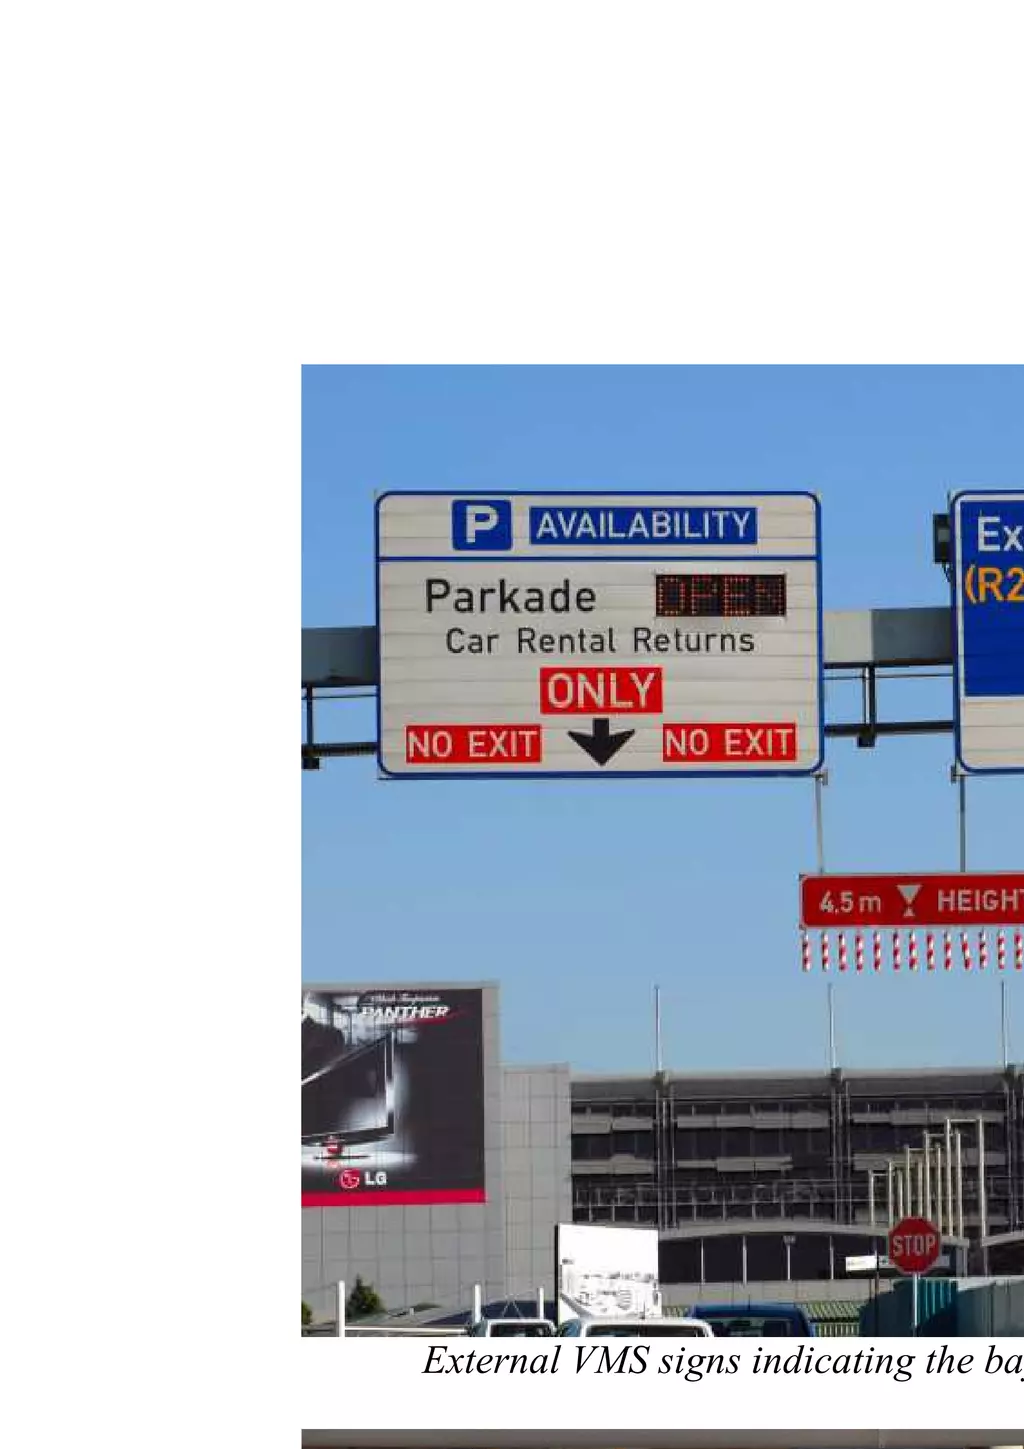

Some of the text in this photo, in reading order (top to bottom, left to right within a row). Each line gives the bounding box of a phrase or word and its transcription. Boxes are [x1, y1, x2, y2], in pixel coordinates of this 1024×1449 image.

[466, 506, 751, 543] P AVAILABILITY
[426, 577, 783, 616] Parkade OPEN
[446, 627, 755, 655] Car Rental Returns
[547, 673, 655, 708] ONLY
[408, 730, 538, 759] NO EXIT
[664, 728, 793, 757] NO EXIT
[362, 1006, 450, 1019] PANTHER
[365, 1171, 387, 1185] LG
[893, 1234, 935, 1256] STOP
